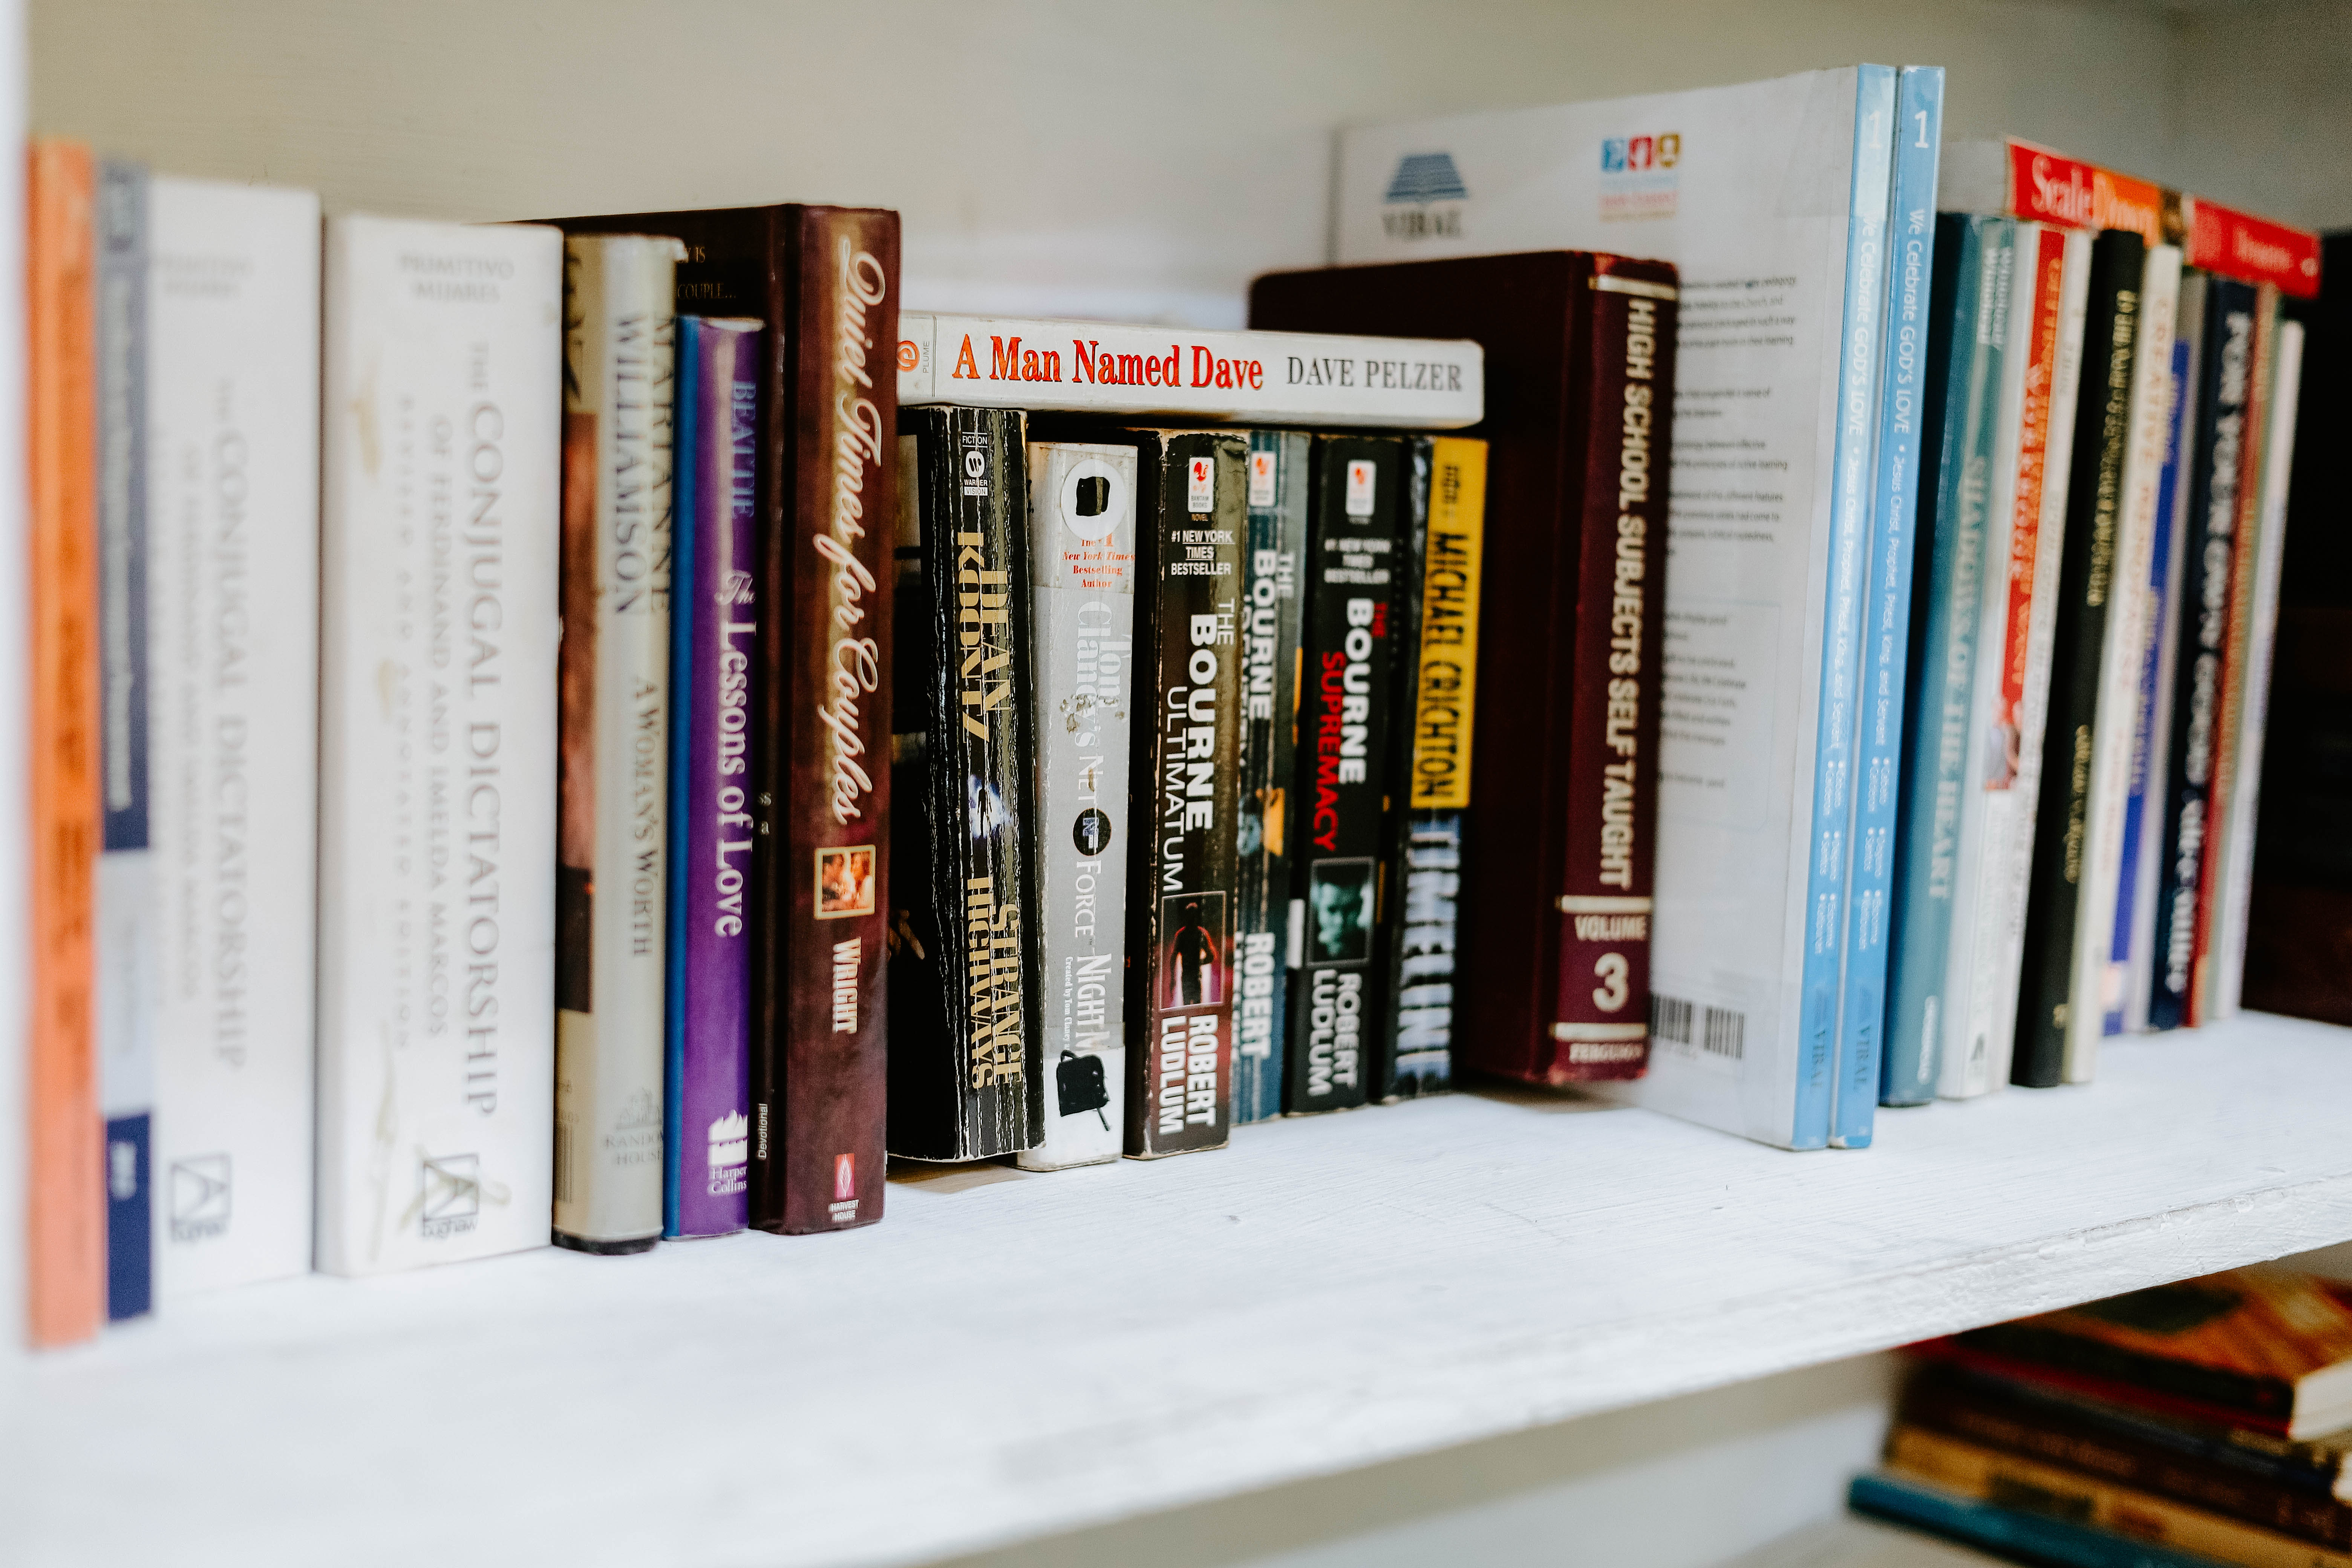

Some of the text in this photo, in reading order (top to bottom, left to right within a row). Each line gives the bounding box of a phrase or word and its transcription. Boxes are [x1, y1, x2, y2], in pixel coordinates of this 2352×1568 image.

[1914, 110, 1929, 149] 1
[952, 334, 1263, 390] A Man Named Dave
[1894, 208, 1925, 433] We Celebrate GOD'S LOVE
[1286, 356, 1463, 392] DAVE PELZER
[616, 317, 649, 615] WILLIAMSON
[730, 380, 757, 520] BEATTIE
[962, 436, 988, 445] FICTION
[461, 400, 504, 700] CONJUGAL
[813, 236, 886, 825] Quiet Times for Couples
[1062, 551, 1136, 561] New York Times
[1073, 565, 1123, 576] Bestselling
[1081, 579, 1113, 588] Author
[1170, 562, 1232, 576] BESTSELLER
[1171, 530, 1233, 543] #1 NEW YORK
[1185, 546, 1214, 559] TIMES
[1277, 551, 1295, 600] THE
[957, 531, 990, 744] KOONTZ
[1216, 598, 1234, 646] THE
[1248, 550, 1276, 720] BOURNE
[1426, 531, 1469, 646] MICHAEL
[1599, 299, 1656, 890] HIGH SCHOOL SUBJECTS SELF TAUGHT
[977, 569, 1012, 718] DEAN
[1099, 634, 1133, 709] Tom
[1338, 597, 1375, 784] BOURNE
[717, 620, 756, 775] Lessons
[1186, 614, 1217, 831] BOURNE
[1418, 660, 1462, 797] CRICHTON
[1162, 686, 1188, 893] ULTIMATUM
[1314, 651, 1346, 851] SUPREMACY
[717, 785, 754, 830] of
[1075, 755, 1105, 938] NET FORCE
[467, 721, 502, 1118] DICTATORSHIP
[634, 848, 659, 958] WORTH
[715, 836, 753, 938] Love
[1574, 915, 1646, 942] VOLUME
[429, 902, 451, 1038] MARCOS
[831, 937, 862, 1034] WRIGHT
[967, 877, 996, 1089] HIGHWAYS
[990, 904, 1022, 1083] STRANGE
[1063, 988, 1072, 996] by
[1065, 956, 1074, 987] Created
[1076, 953, 1112, 1026] NIGHT
[1240, 932, 1276, 1060] ROBERT
[1395, 815, 1461, 1080] TIMELINE
[1592, 952, 1629, 1013] 3
[1063, 1016, 1073, 1040] Clancy
[1064, 998, 1073, 1015] Tom
[1307, 969, 1337, 1096] LUDLUM
[1333, 972, 1362, 1088] ROBERT
[1158, 1015, 1187, 1135] LUDLUM
[1187, 1014, 1219, 1127] ROBERT
[711, 1165, 747, 1181] Harper
[758, 1103, 768, 1159] Devotional
[709, 1179, 747, 1195] Collins
[829, 1199, 859, 1212] HARVEST
[832, 1210, 856, 1222] HOUSE
